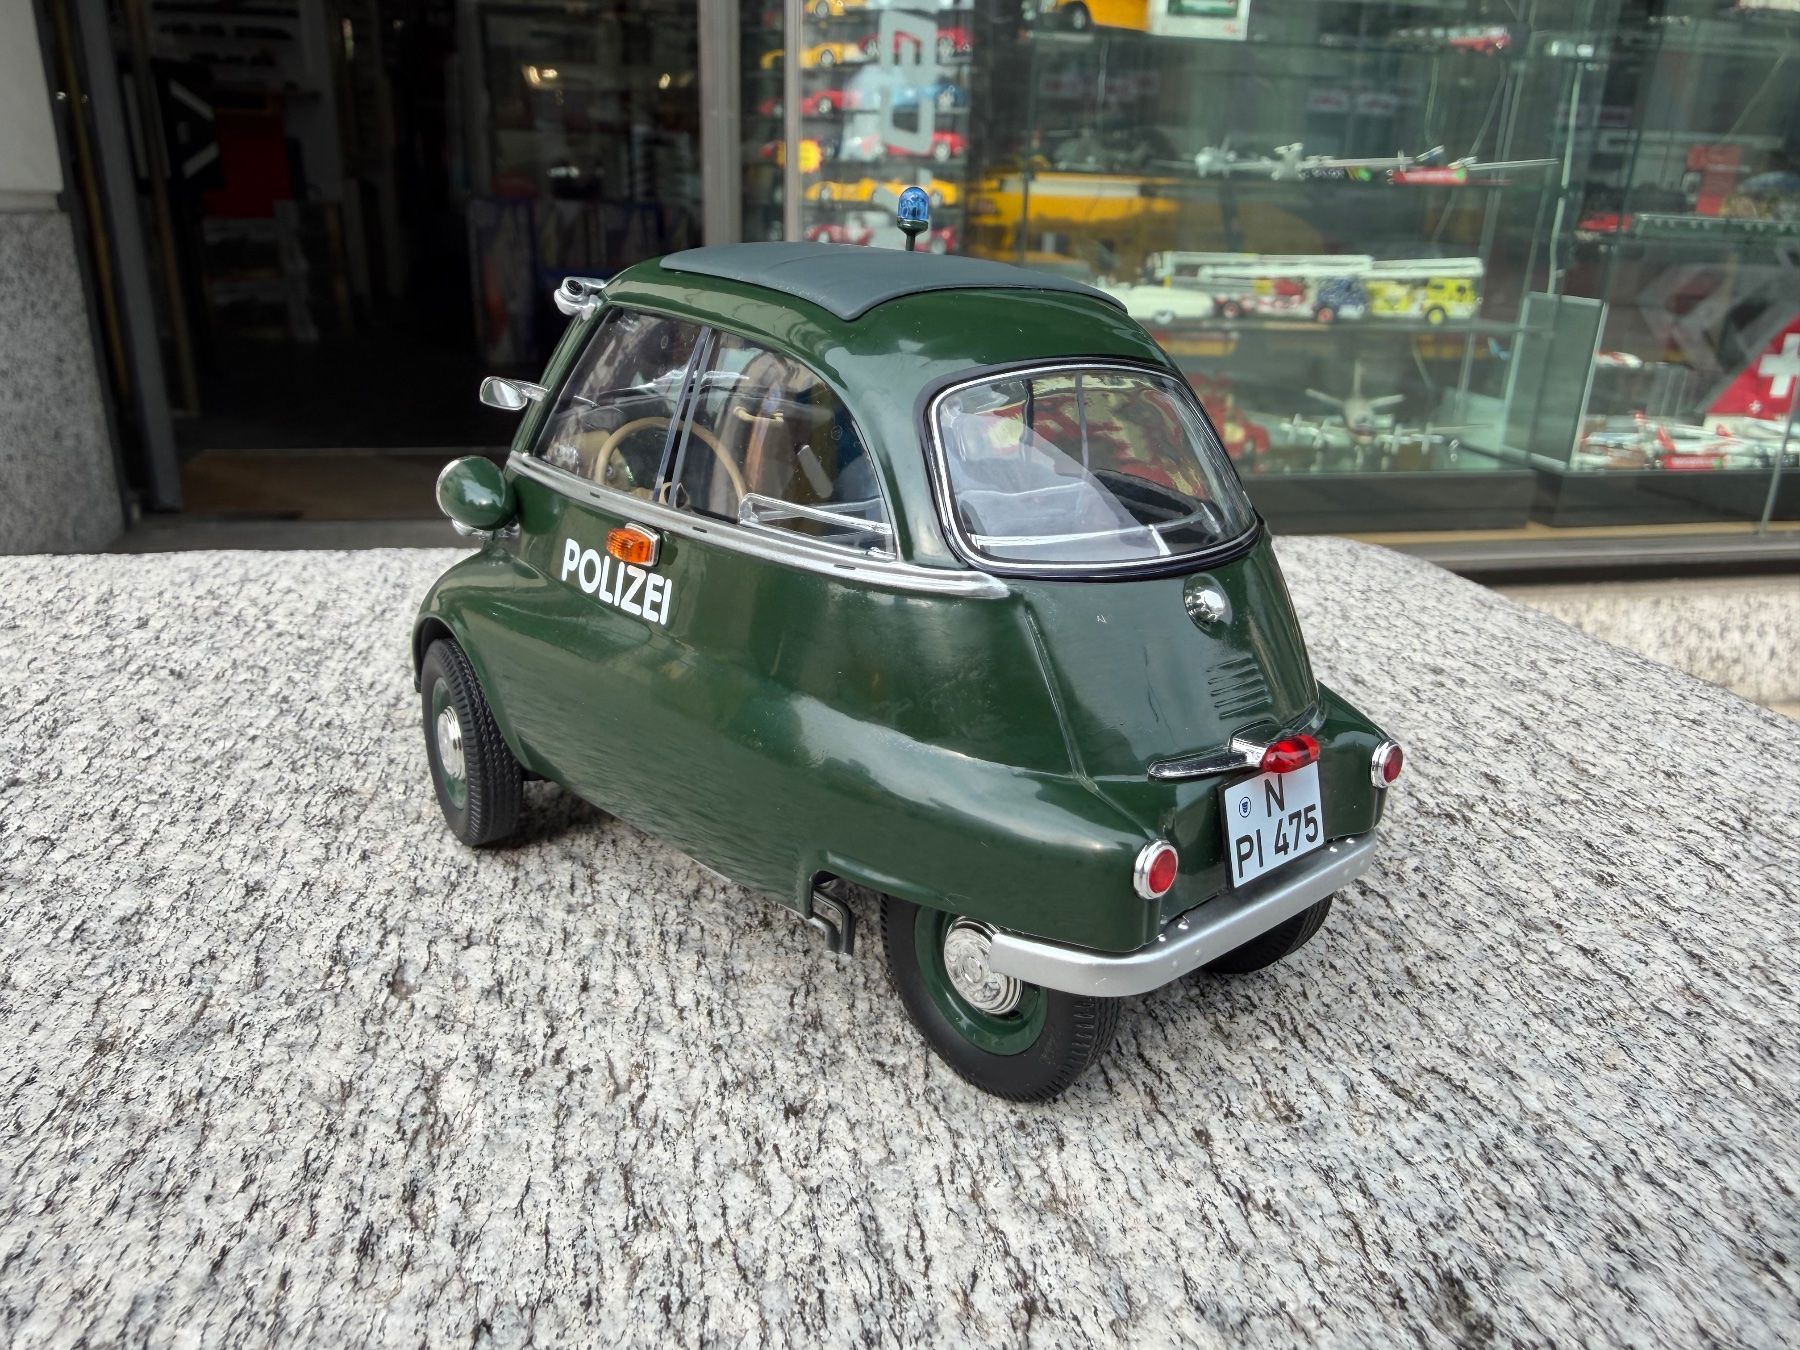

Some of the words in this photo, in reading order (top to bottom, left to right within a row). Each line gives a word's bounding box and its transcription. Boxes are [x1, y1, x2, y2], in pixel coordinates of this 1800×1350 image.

[561, 538, 673, 625] POLIZEI
[1263, 773, 1285, 818] N
[1235, 828, 1264, 878] PI
[1274, 803, 1319, 856] 475
